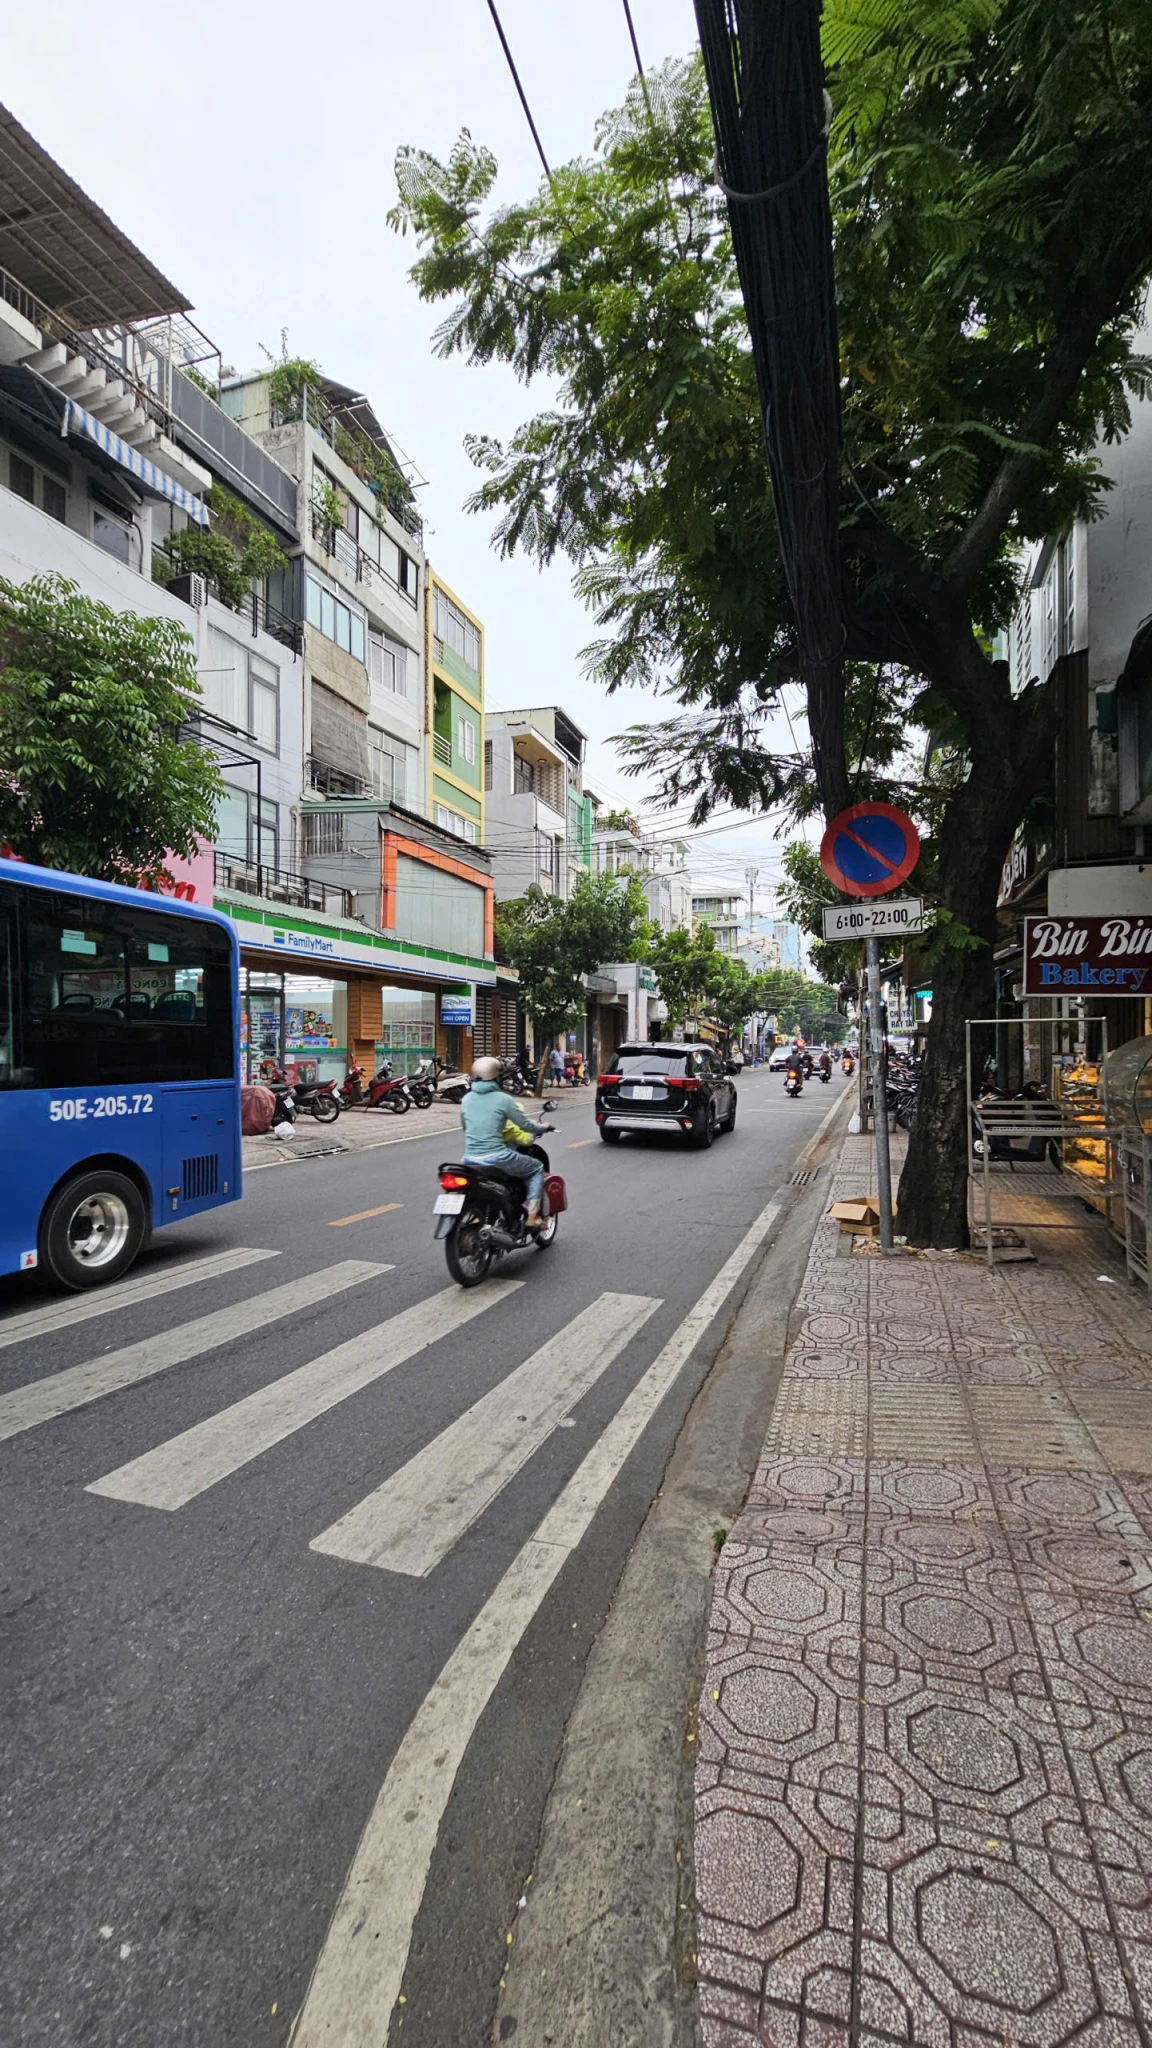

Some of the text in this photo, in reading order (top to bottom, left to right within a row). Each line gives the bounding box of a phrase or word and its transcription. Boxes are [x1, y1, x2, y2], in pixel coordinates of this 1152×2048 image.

[836, 908, 908, 930] 6:00-22:00
[288, 933, 334, 952] FamilyMart
[1031, 919, 1152, 958] Bin Bin
[1039, 962, 1148, 991] Bakery
[49, 1093, 154, 1122] 50E-205.72
